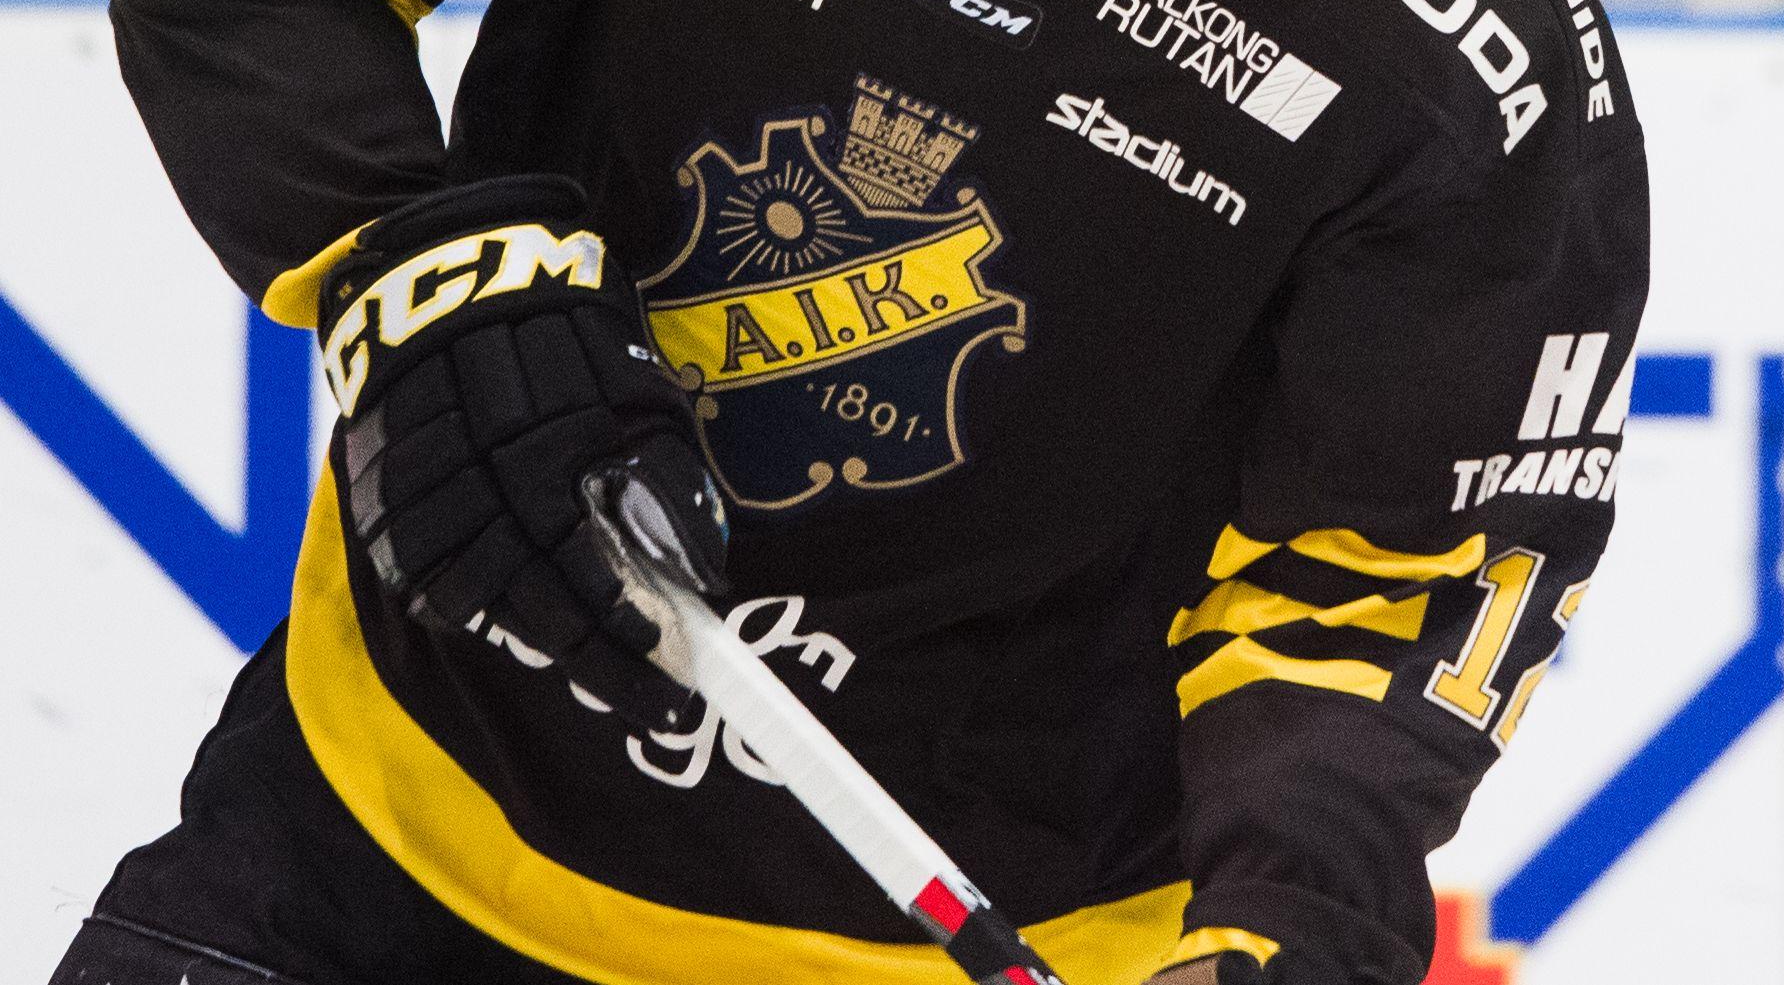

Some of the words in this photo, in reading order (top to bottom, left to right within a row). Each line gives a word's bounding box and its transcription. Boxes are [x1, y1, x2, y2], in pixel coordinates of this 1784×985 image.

[1045, 92, 1247, 225] stadium
[324, 223, 606, 417] CCM
[720, 259, 949, 374] A.I.K.
